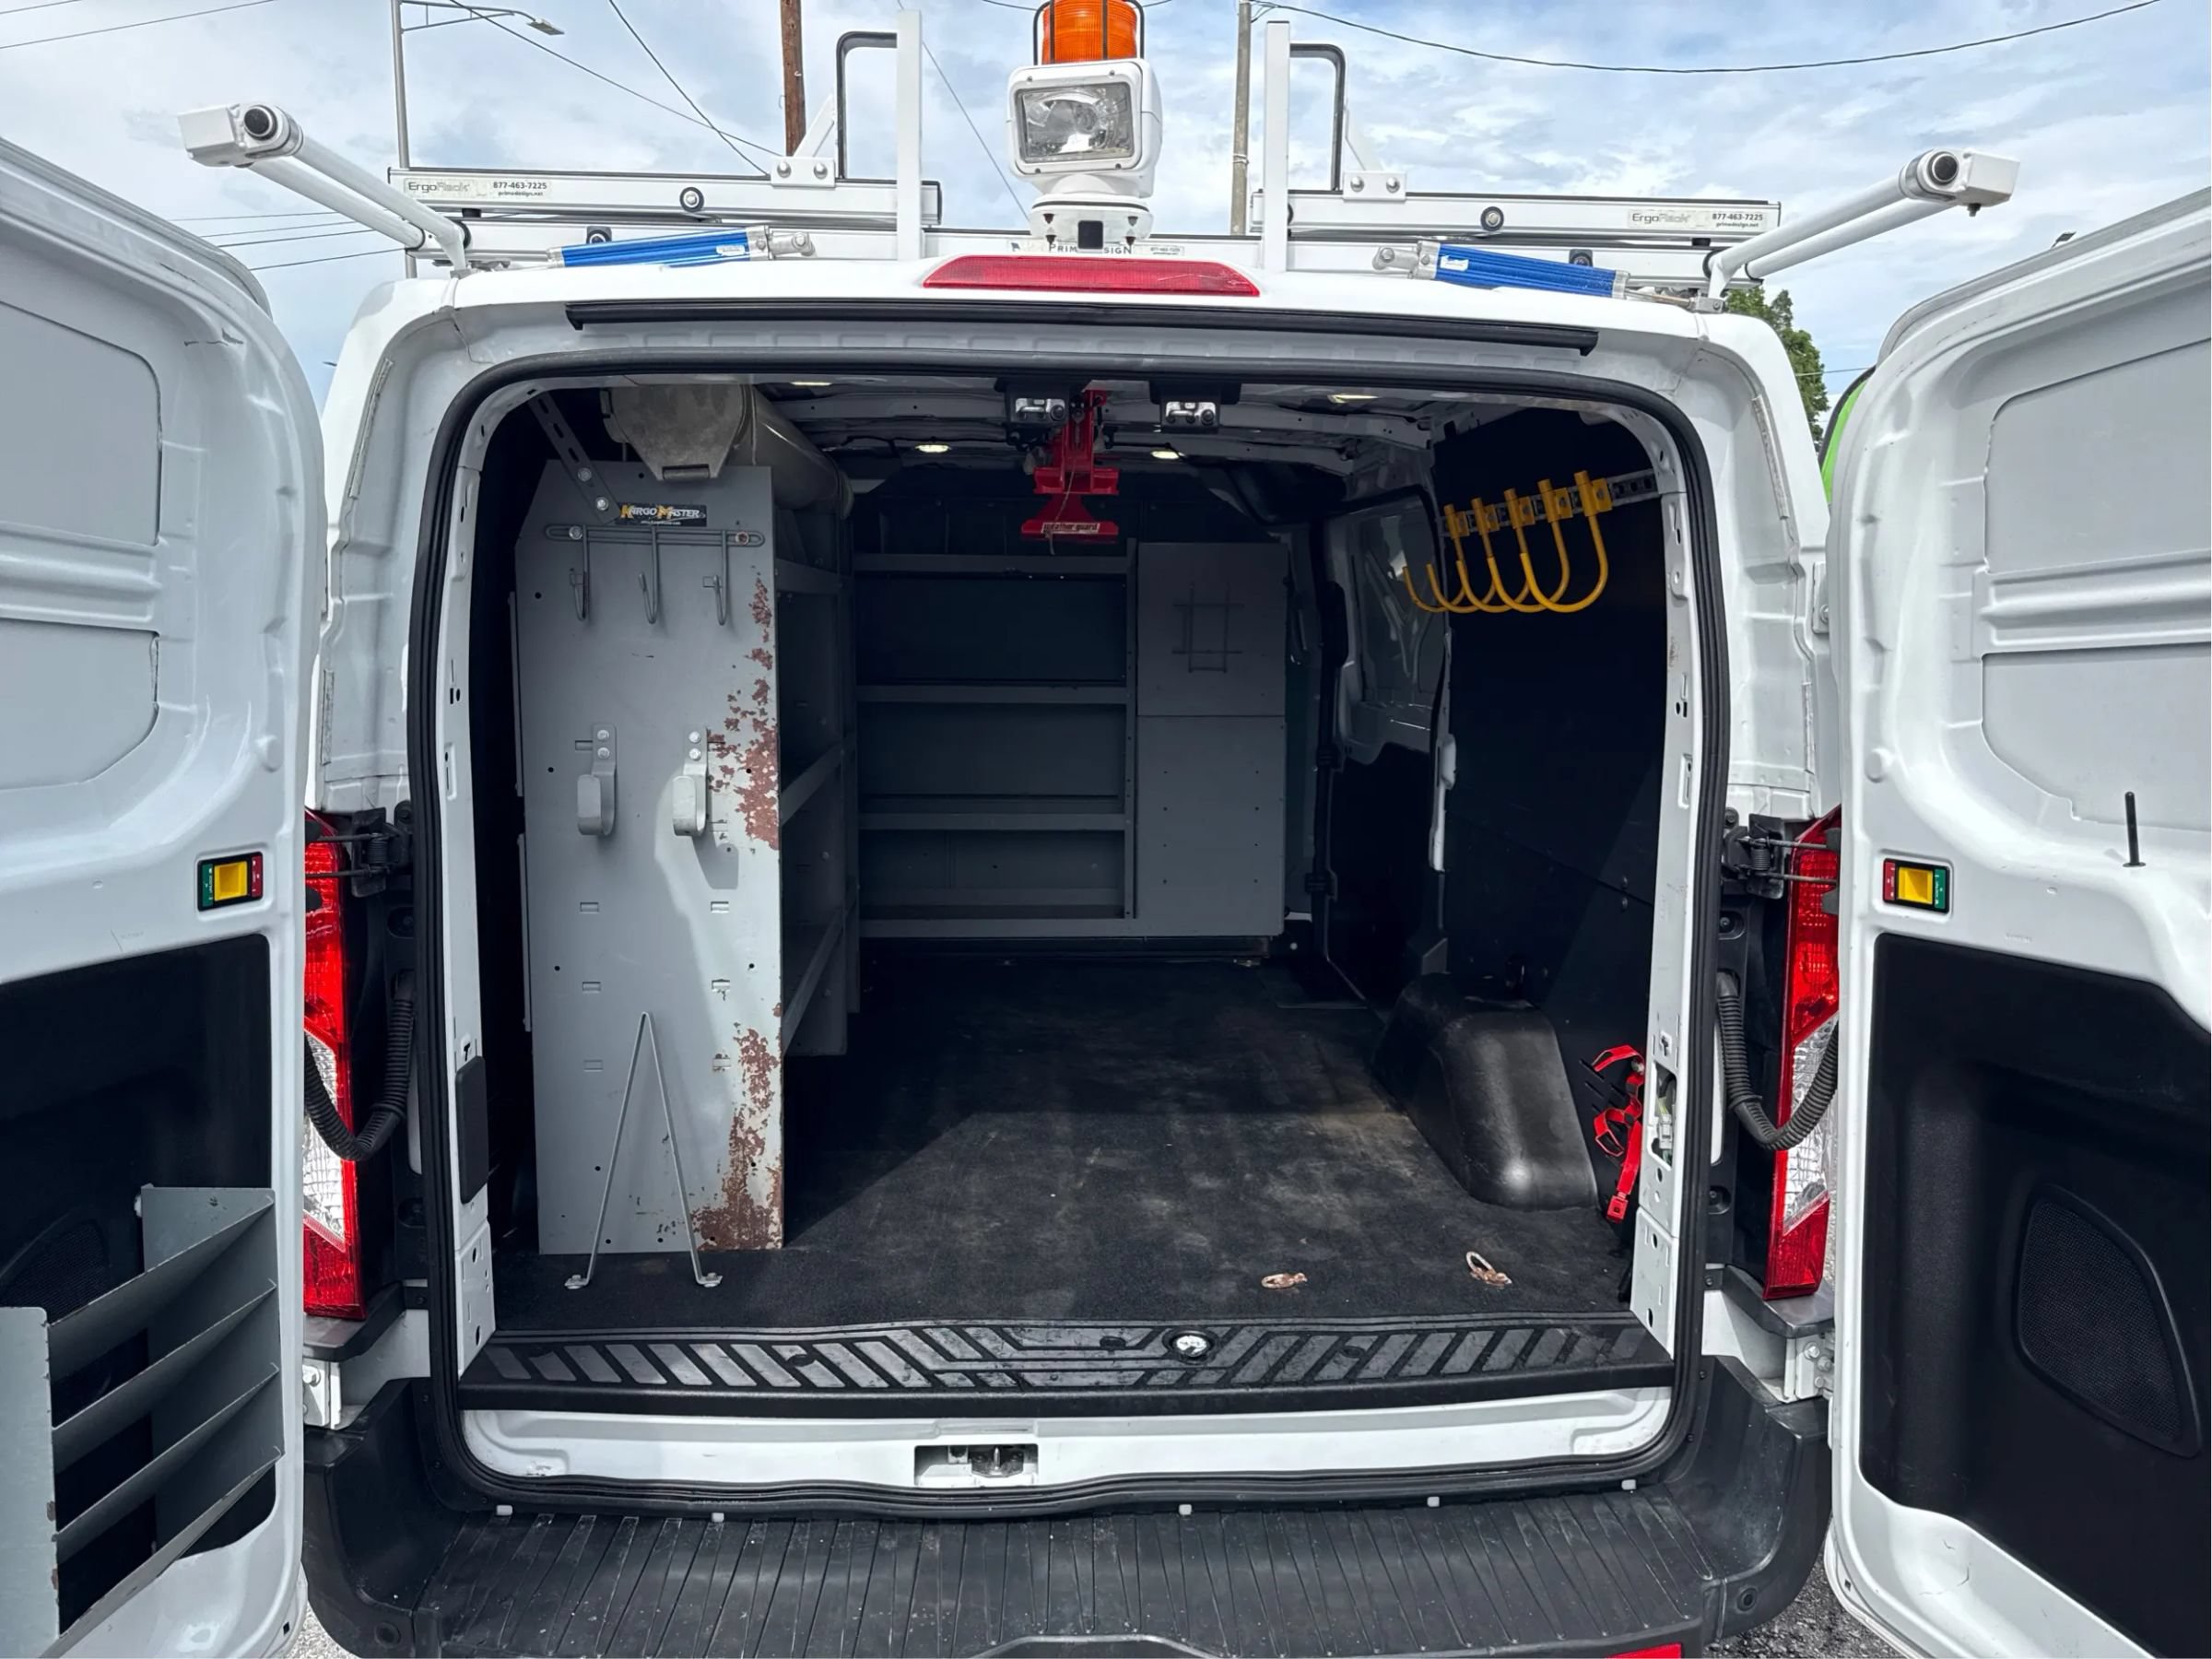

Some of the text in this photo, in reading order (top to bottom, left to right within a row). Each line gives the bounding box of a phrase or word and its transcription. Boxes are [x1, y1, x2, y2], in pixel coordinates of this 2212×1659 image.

[493, 182, 547, 190] 877-463-7225
[1712, 213, 1763, 222] 877-463-7225
[1049, 244, 1133, 254] PRIM SIGN
[619, 504, 700, 520] KARGO MASTER
